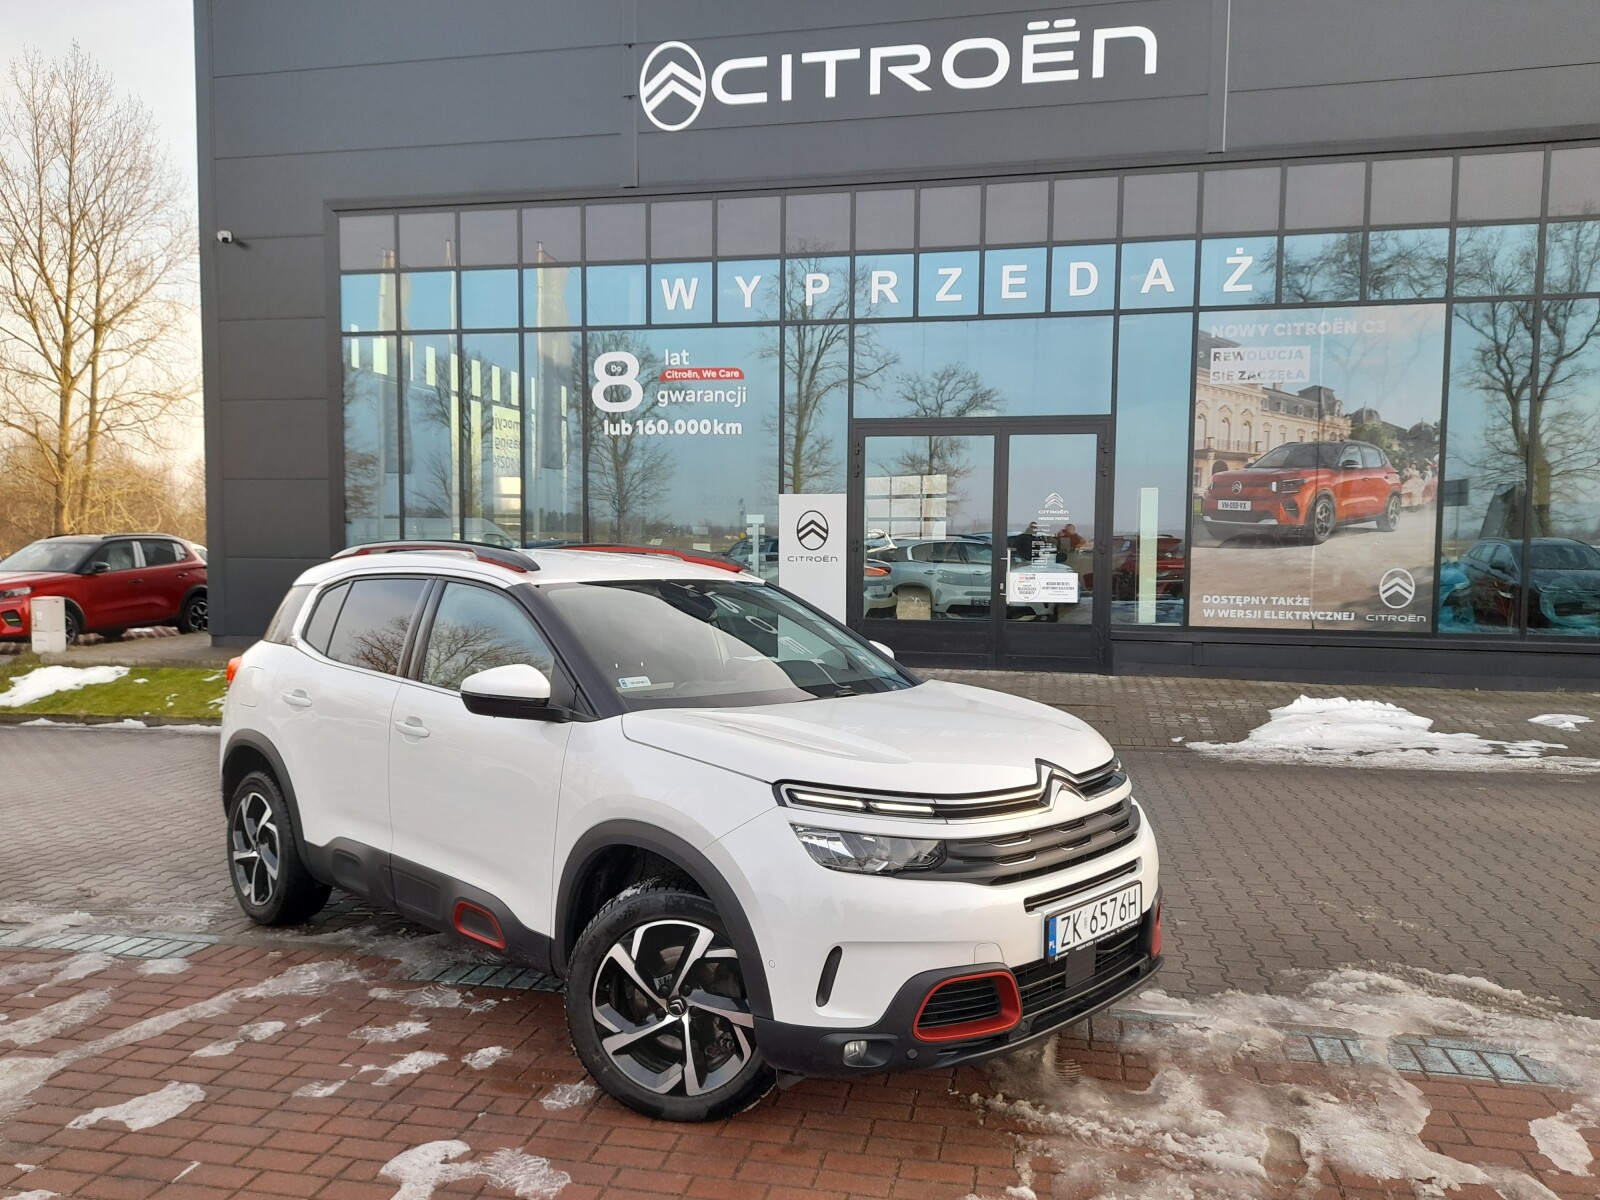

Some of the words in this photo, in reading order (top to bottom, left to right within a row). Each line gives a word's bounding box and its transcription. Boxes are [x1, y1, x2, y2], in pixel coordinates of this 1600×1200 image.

[711, 18, 1158, 105] CITROËN
[661, 247, 1254, 310] WYPRZEDAŻ
[1211, 323, 1269, 338] NOWY
[1273, 318, 1358, 337] CITROËN
[1361, 319, 1386, 334] C3
[664, 348, 690, 366] lat
[1212, 350, 1304, 362] REWOLUCJA
[610, 364, 622, 373] Do
[665, 369, 700, 380] Citroën,
[702, 369, 717, 378] We
[718, 369, 740, 379] Care
[591, 351, 644, 413] 8
[657, 386, 747, 408] gwarancji
[603, 419, 633, 436] lub
[787, 555, 838, 563] CITROËN
[1203, 595, 1268, 607] DOSTĘPNY
[1270, 595, 1310, 606] TAKŻE
[1203, 608, 1215, 618] W
[1217, 609, 1261, 619] WERSJI
[1264, 610, 1355, 621] ELEKTRYCZNEJ
[1365, 613, 1427, 623] CITROËN
[1060, 910, 1082, 948] ZK
[1089, 888, 1137, 935] 6576H
[1048, 940, 1056, 951] PL
